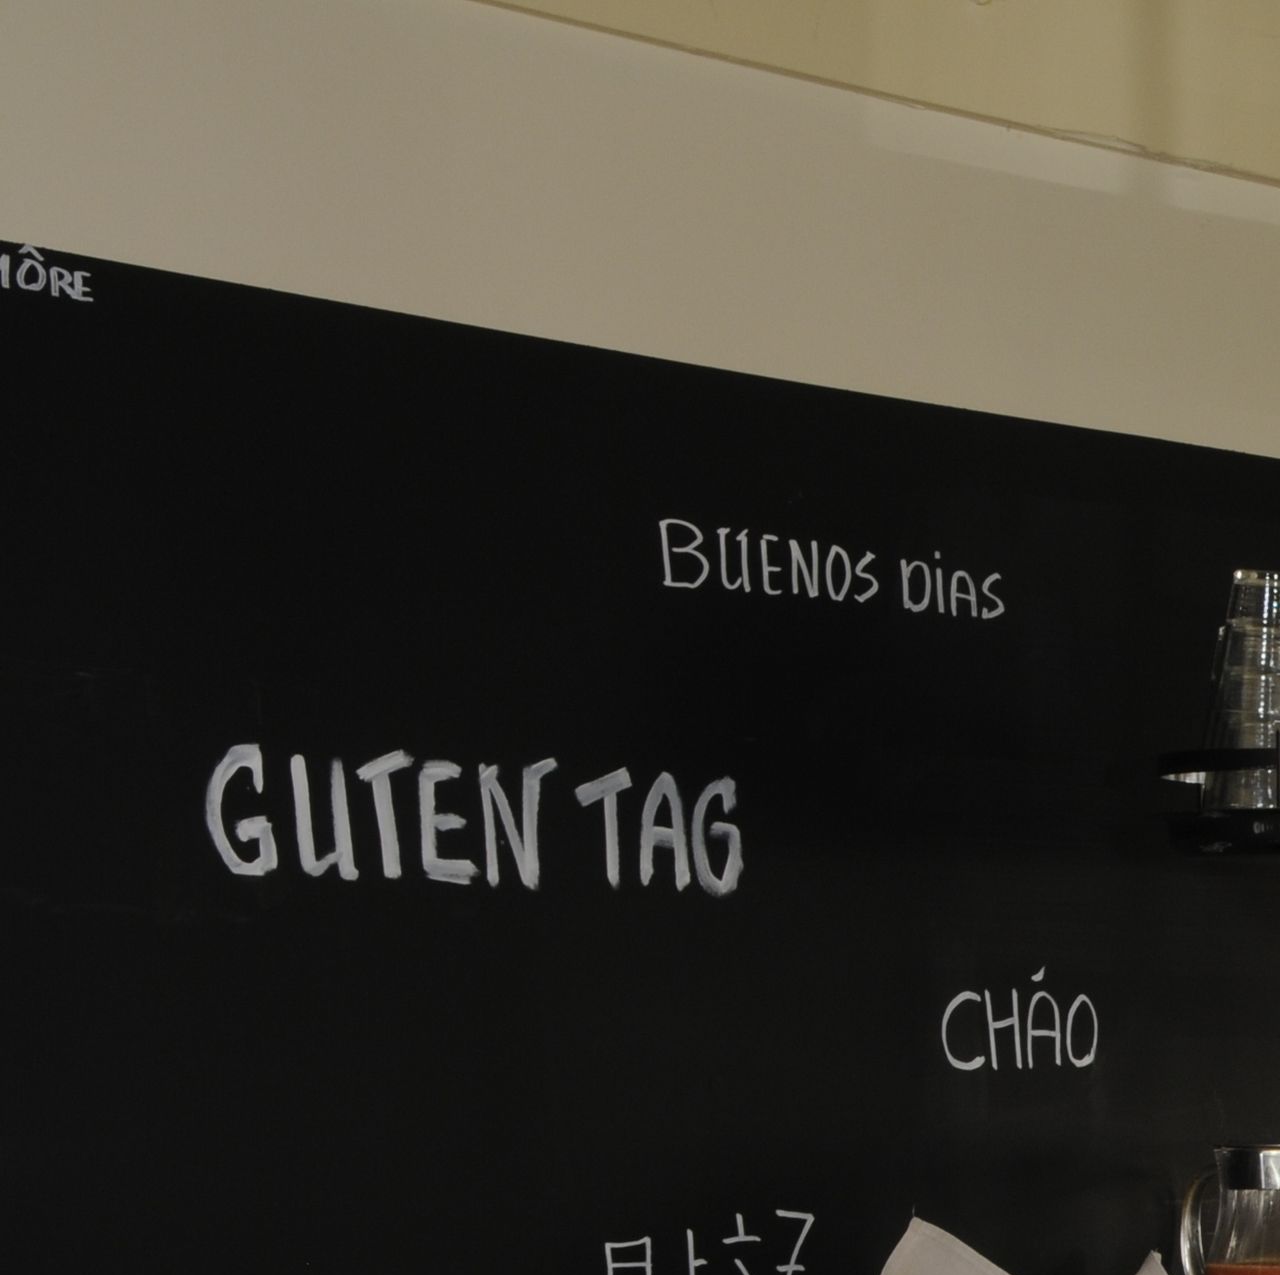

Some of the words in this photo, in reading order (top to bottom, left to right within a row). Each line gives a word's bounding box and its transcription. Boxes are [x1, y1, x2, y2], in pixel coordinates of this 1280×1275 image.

[658, 518, 879, 603] BUENOS
[205, 743, 558, 891] GUTEN
[574, 766, 744, 896] TAG
[941, 966, 1098, 1071] CHÁO
